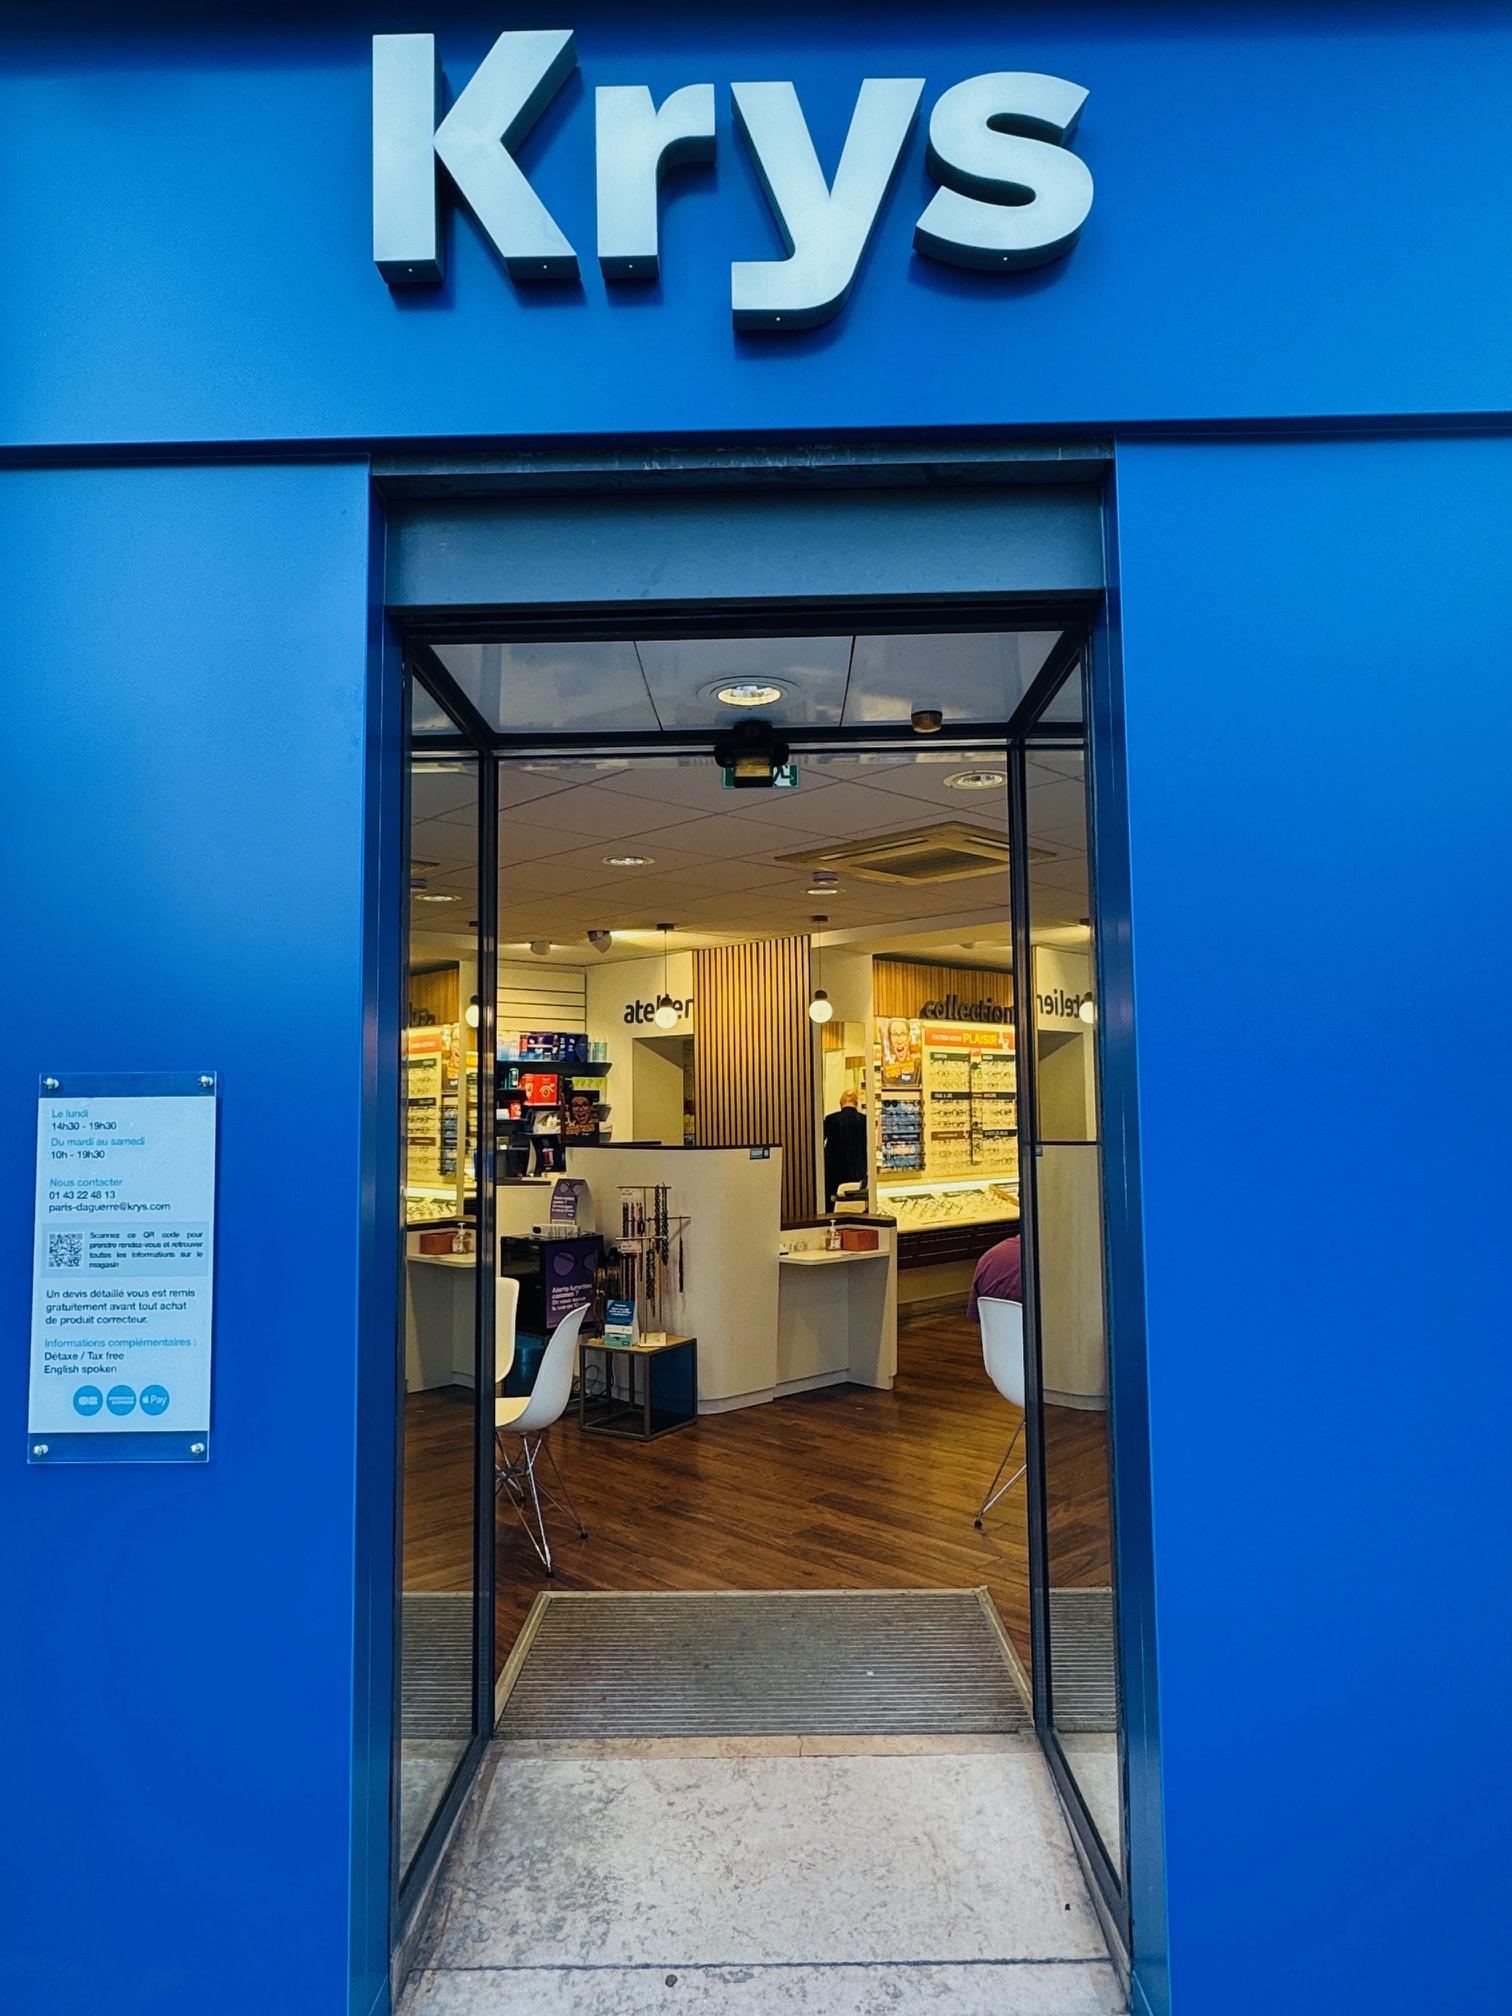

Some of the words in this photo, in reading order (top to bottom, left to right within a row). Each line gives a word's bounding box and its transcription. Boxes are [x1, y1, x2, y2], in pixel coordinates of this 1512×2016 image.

[372, 29, 1094, 322] Krys
[624, 995, 694, 1024] ateler
[962, 1033, 997, 1045] PLAISIR
[52, 1110, 64, 1118] Le
[65, 1109, 89, 1118] lundi
[51, 1122, 80, 1130] 14h30
[89, 1122, 117, 1130] 19h30
[51, 1138, 65, 1146] Du
[67, 1137, 94, 1146] mardi
[111, 1137, 145, 1146] samedi
[51, 1151, 68, 1159] 10h
[77, 1150, 105, 1159] 19h30
[49, 1179, 75, 1187] Nous
[77, 1179, 123, 1187] contacter
[49, 1192, 60, 1200] 01
[63, 1191, 75, 1200] 43
[77, 1191, 88, 1199] 22
[105, 1191, 116, 1199] 13
[49, 1202, 171, 1213] paris-daguerre@krys.com
[143, 1231, 155, 1239] QR
[187, 1232, 203, 1240] pour
[89, 1242, 116, 1250] prendre
[118, 1241, 161, 1249] rendez-vous
[89, 1261, 119, 1269] magasin
[46, 1290, 60, 1298] Un
[62, 1289, 88, 1298] devis
[90, 1289, 124, 1298] détaillé
[126, 1290, 149, 1298] vous
[152, 1289, 167, 1297] est
[169, 1289, 195, 1297] remis
[46, 1302, 107, 1313] gratuitement
[109, 1303, 136, 1311] avant
[139, 1302, 157, 1311] tout
[160, 1302, 187, 1310] achat
[45, 1316, 57, 1325] de
[60, 1316, 94, 1326] produit
[96, 1316, 148, 1324] correcteur.
[45, 1338, 106, 1348] Informations
[108, 1338, 192, 1348] complémentaires
[44, 1352, 78, 1361] Détaxe
[87, 1352, 103, 1360] Tax
[106, 1352, 124, 1360] free
[44, 1365, 79, 1375] English
[82, 1364, 117, 1374] spoken
[150, 1396, 167, 1406] Pay
